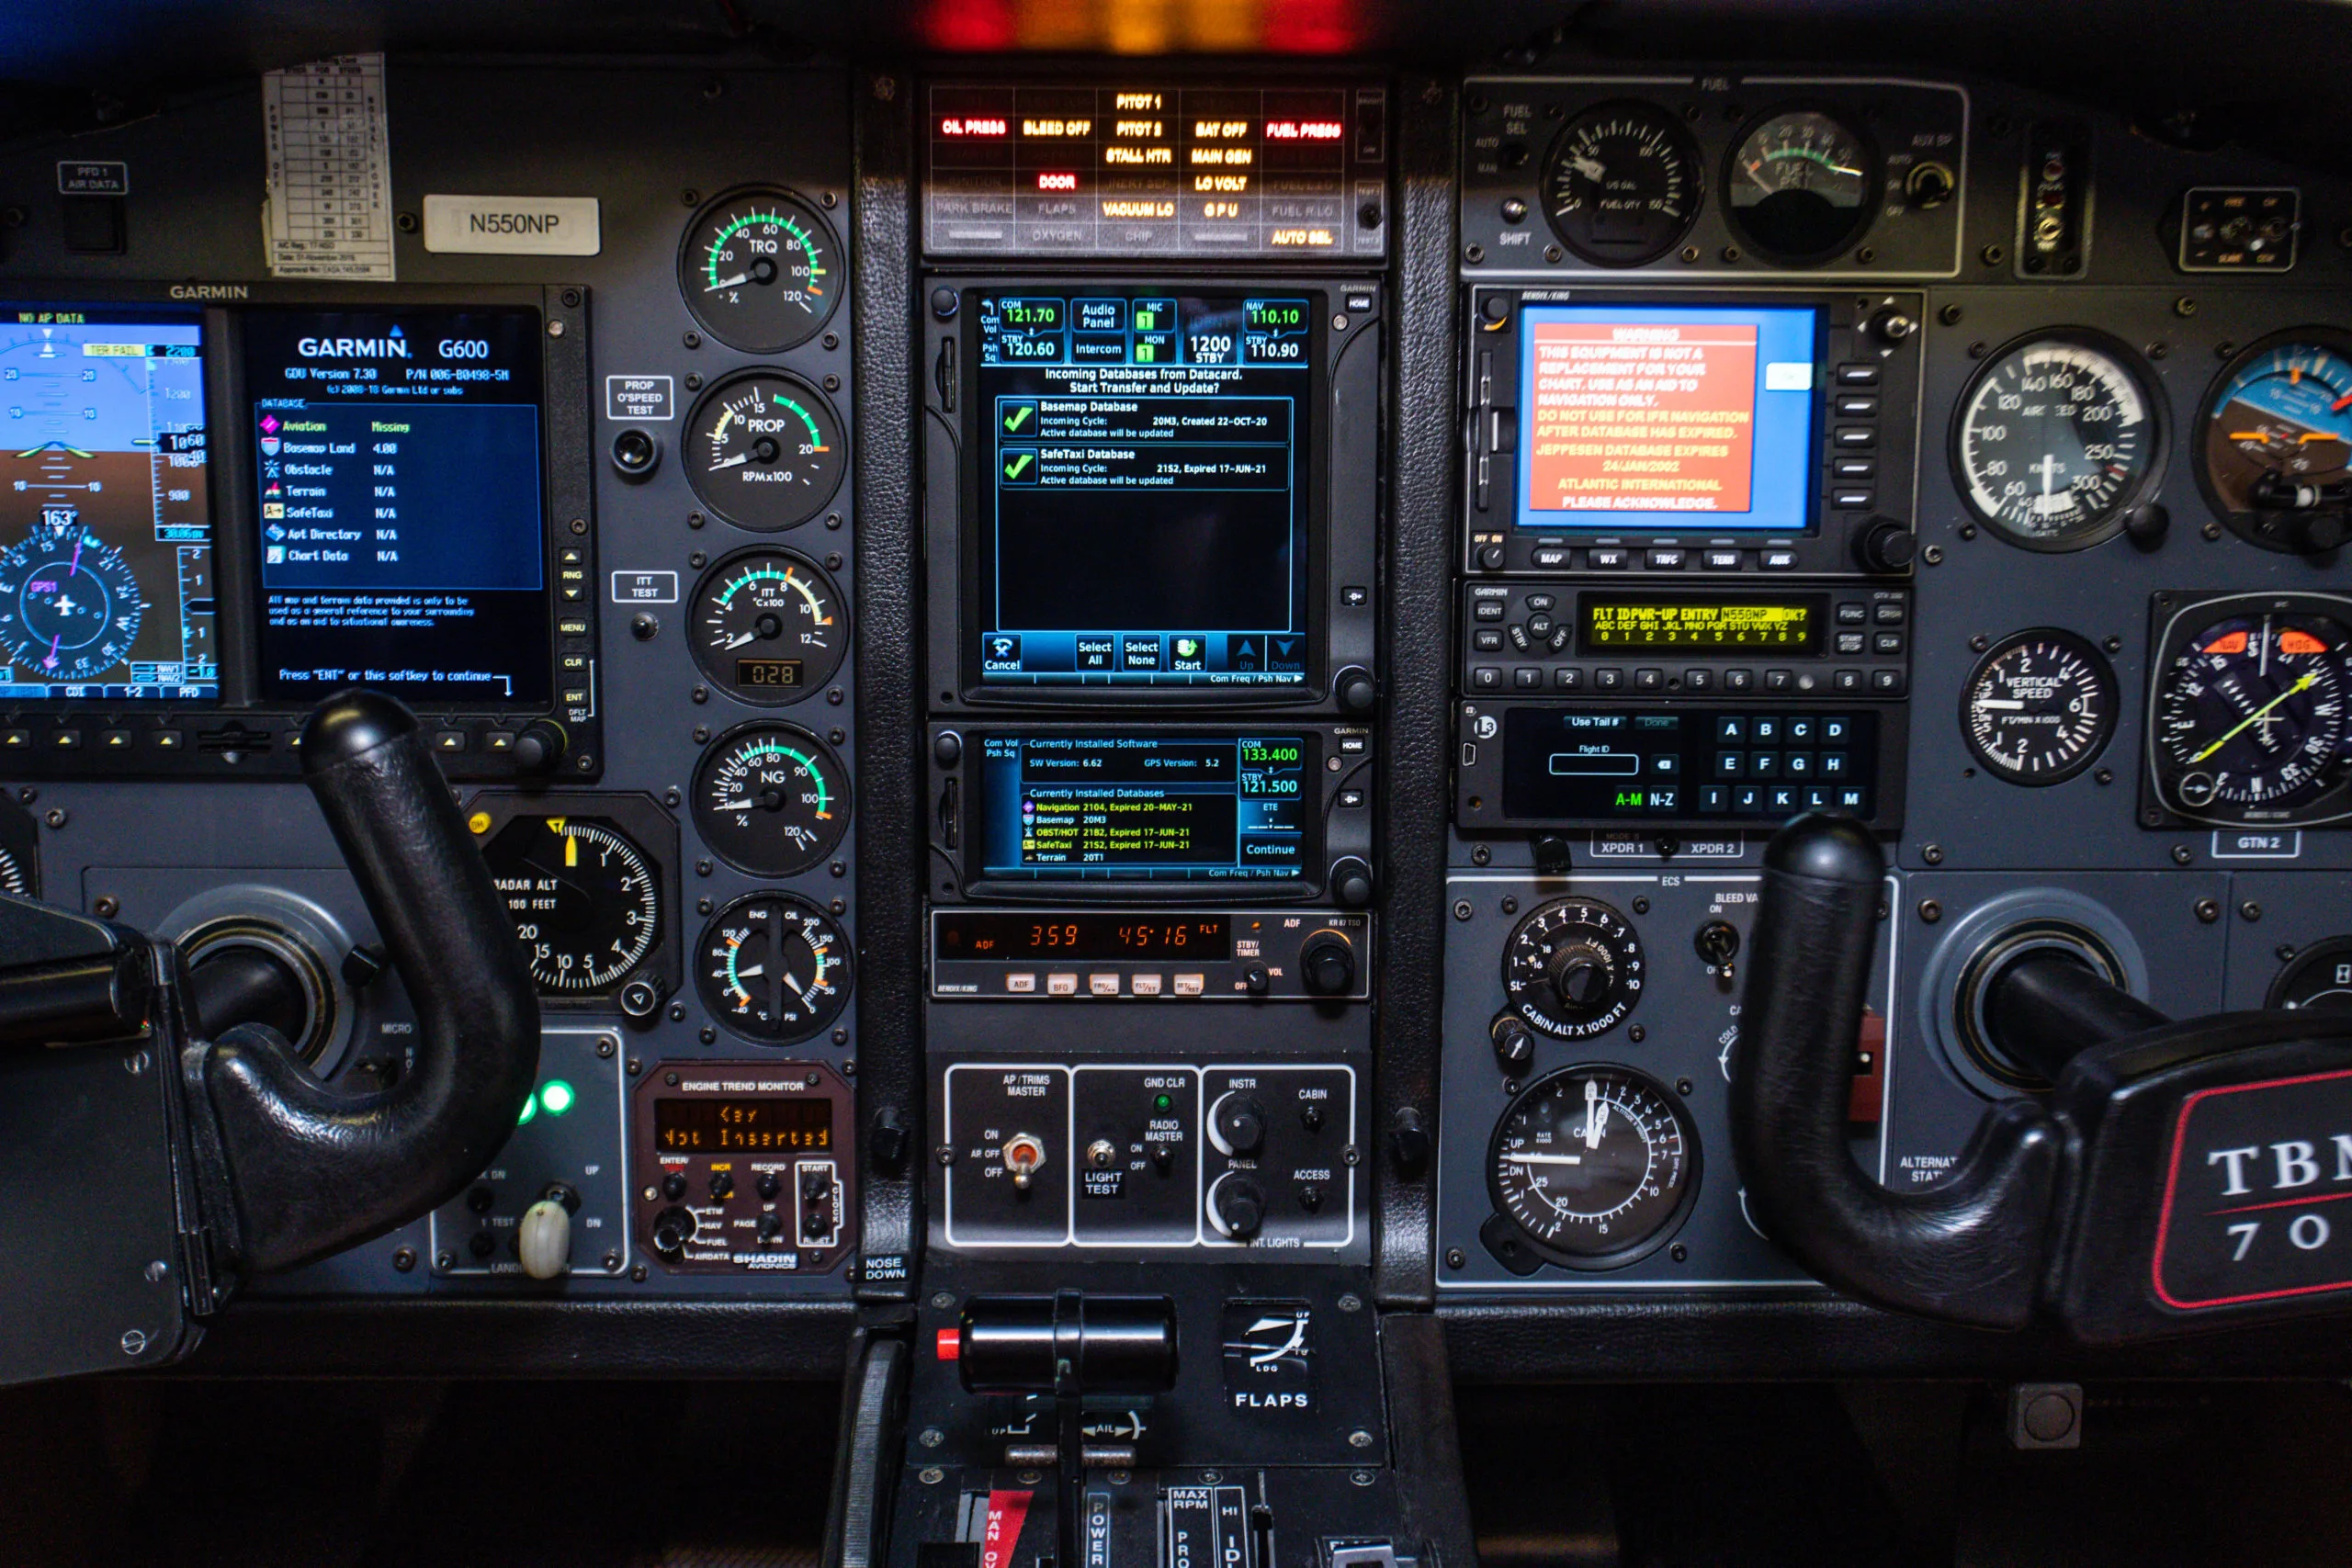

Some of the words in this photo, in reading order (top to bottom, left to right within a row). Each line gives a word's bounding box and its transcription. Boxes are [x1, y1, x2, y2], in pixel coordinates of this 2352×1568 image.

[1117, 94, 1152, 109] PITOT
[1155, 95, 1161, 109] 1
[943, 119, 963, 134] OIL
[966, 119, 1006, 135] PRESS
[1023, 120, 1064, 135] BLEED
[1066, 121, 1091, 135] OFF
[1117, 121, 1152, 137] PITOT
[1154, 121, 1161, 137] 2
[1195, 121, 1220, 137] BAT
[1222, 122, 1247, 137] OFF
[1267, 122, 1299, 138] FUEL
[1300, 123, 1341, 138] PRESS
[1106, 149, 1144, 163] STALL
[1147, 149, 1171, 163] HTR
[1192, 149, 1223, 164] MAIN
[1225, 149, 1251, 164] GEN
[1039, 175, 1075, 189] DOOR
[1195, 176, 1213, 191] LO
[1215, 176, 1247, 191] VOLT
[1103, 202, 1155, 217] VACUUM
[1157, 202, 1173, 217] LO
[471, 214, 560, 233] N550NP
[1272, 230, 1307, 244] AUTO
[1308, 230, 1333, 244] SEL
[1500, 232, 1531, 245] SHIFT
[750, 240, 777, 254] TRQ
[1082, 304, 1114, 317] Audio
[1148, 302, 1162, 312] MIC
[38, 312, 53, 323] AP
[56, 312, 85, 323] DATA
[1006, 308, 1054, 321] 121.70
[1250, 310, 1298, 323] 110.10
[1083, 316, 1114, 328] Panel
[1144, 335, 1164, 345] MON
[1191, 335, 1231, 352] 1200
[439, 340, 489, 358] G600
[1008, 342, 1055, 355] 120.60
[1077, 344, 1121, 354] Intercom
[1251, 344, 1298, 357] 110.90
[1196, 352, 1224, 364] STBY
[286, 367, 307, 378] GDU
[311, 368, 350, 379] Version
[1046, 368, 1096, 381] Incoming
[1100, 367, 1157, 382] Databases
[1160, 367, 1186, 379] from
[626, 381, 654, 389] PROP
[1069, 381, 1099, 393] Start
[1100, 381, 1148, 393] Transfer
[1149, 381, 1171, 393] and
[1173, 381, 1220, 396] Update?
[628, 406, 653, 414] TEST
[1041, 401, 1087, 413] Basemap
[1091, 401, 1137, 412] Database
[283, 422, 326, 431] Aviation
[749, 419, 785, 432] PROP
[1153, 416, 1179, 426] 20M3,
[1182, 417, 1215, 425] Created
[1217, 417, 1267, 425] 22-OCT-20
[372, 422, 410, 433] Missing
[284, 442, 327, 454] Basemap
[330, 443, 356, 454] Land
[285, 464, 333, 475] Obstacle
[374, 465, 395, 476] N/A
[1557, 479, 1619, 491] ATLANTIC
[1621, 479, 1723, 491] INTERNATIONAL
[1563, 496, 1611, 508] PLEASE
[287, 507, 334, 518] SafeTaxi
[376, 508, 397, 518] N/A
[288, 529, 308, 540] Apt
[311, 528, 362, 540] Directory
[377, 530, 397, 540] N/A
[1541, 554, 1563, 564] MAP
[1600, 554, 1617, 564] WX
[762, 588, 775, 596] ITT
[1080, 642, 1112, 651] Select
[1125, 642, 1158, 651] Select
[1089, 655, 1102, 664] All
[1129, 655, 1155, 664] None
[984, 660, 1021, 671] Cancel
[1174, 660, 1201, 671] Start
[279, 669, 311, 680] Press
[348, 671, 361, 680] or
[365, 670, 386, 681] this
[389, 670, 429, 682] softkey
[433, 671, 445, 681] to
[447, 671, 492, 681] continue
[2007, 676, 2061, 687] VERTICAL
[2013, 688, 2052, 698] SPEED
[1572, 717, 1590, 726] Use
[1593, 717, 1611, 726] Tail
[1612, 717, 1619, 726] #
[1030, 739, 1073, 750] Currently
[1076, 739, 1114, 748] Installed
[1117, 739, 1158, 748] Software
[1579, 745, 1600, 754] Flight
[1244, 749, 1297, 761] 133.400
[1046, 759, 1079, 767] Version:
[1083, 759, 1102, 767] 6.62
[761, 771, 786, 784] NG
[1242, 779, 1297, 792] 121.500
[1616, 794, 1642, 805] A-M
[1650, 793, 1673, 806] N-Z
[1036, 804, 1080, 812] Navigation
[1083, 804, 1107, 812] 2104,
[1110, 804, 1140, 812] Expired
[1602, 843, 1634, 852] XPDR
[1639, 844, 1643, 852] 1
[2238, 837, 2268, 848] GTN
[2270, 837, 2279, 848] 2
[1247, 844, 1295, 853] Continue
[1662, 876, 1679, 886] ECS
[509, 899, 526, 909] 100
[533, 899, 556, 908] FEET
[683, 1082, 719, 1090] ENGINE
[722, 1082, 755, 1090] TREND
[758, 1082, 804, 1090] MONITOR
[1145, 1077, 1164, 1088] GND
[1167, 1077, 1185, 1088] CLR
[1229, 1079, 1256, 1089] INSTR
[1299, 1089, 1327, 1099] CABIN
[1150, 1121, 1178, 1130] RADIO
[1146, 1132, 1182, 1141] MASTER
[1228, 1159, 1257, 1168] PANEL
[1086, 1172, 1122, 1182] LIGHT
[1294, 1170, 1329, 1179] ACCESS
[1086, 1184, 1118, 1194] TEST
[1267, 1236, 1300, 1248] LIGHTS
[733, 1253, 797, 1263] SHADIN
[866, 1258, 901, 1268] NOSE
[866, 1269, 906, 1279] DOWN
[1236, 1393, 1307, 1406] FLAPS
